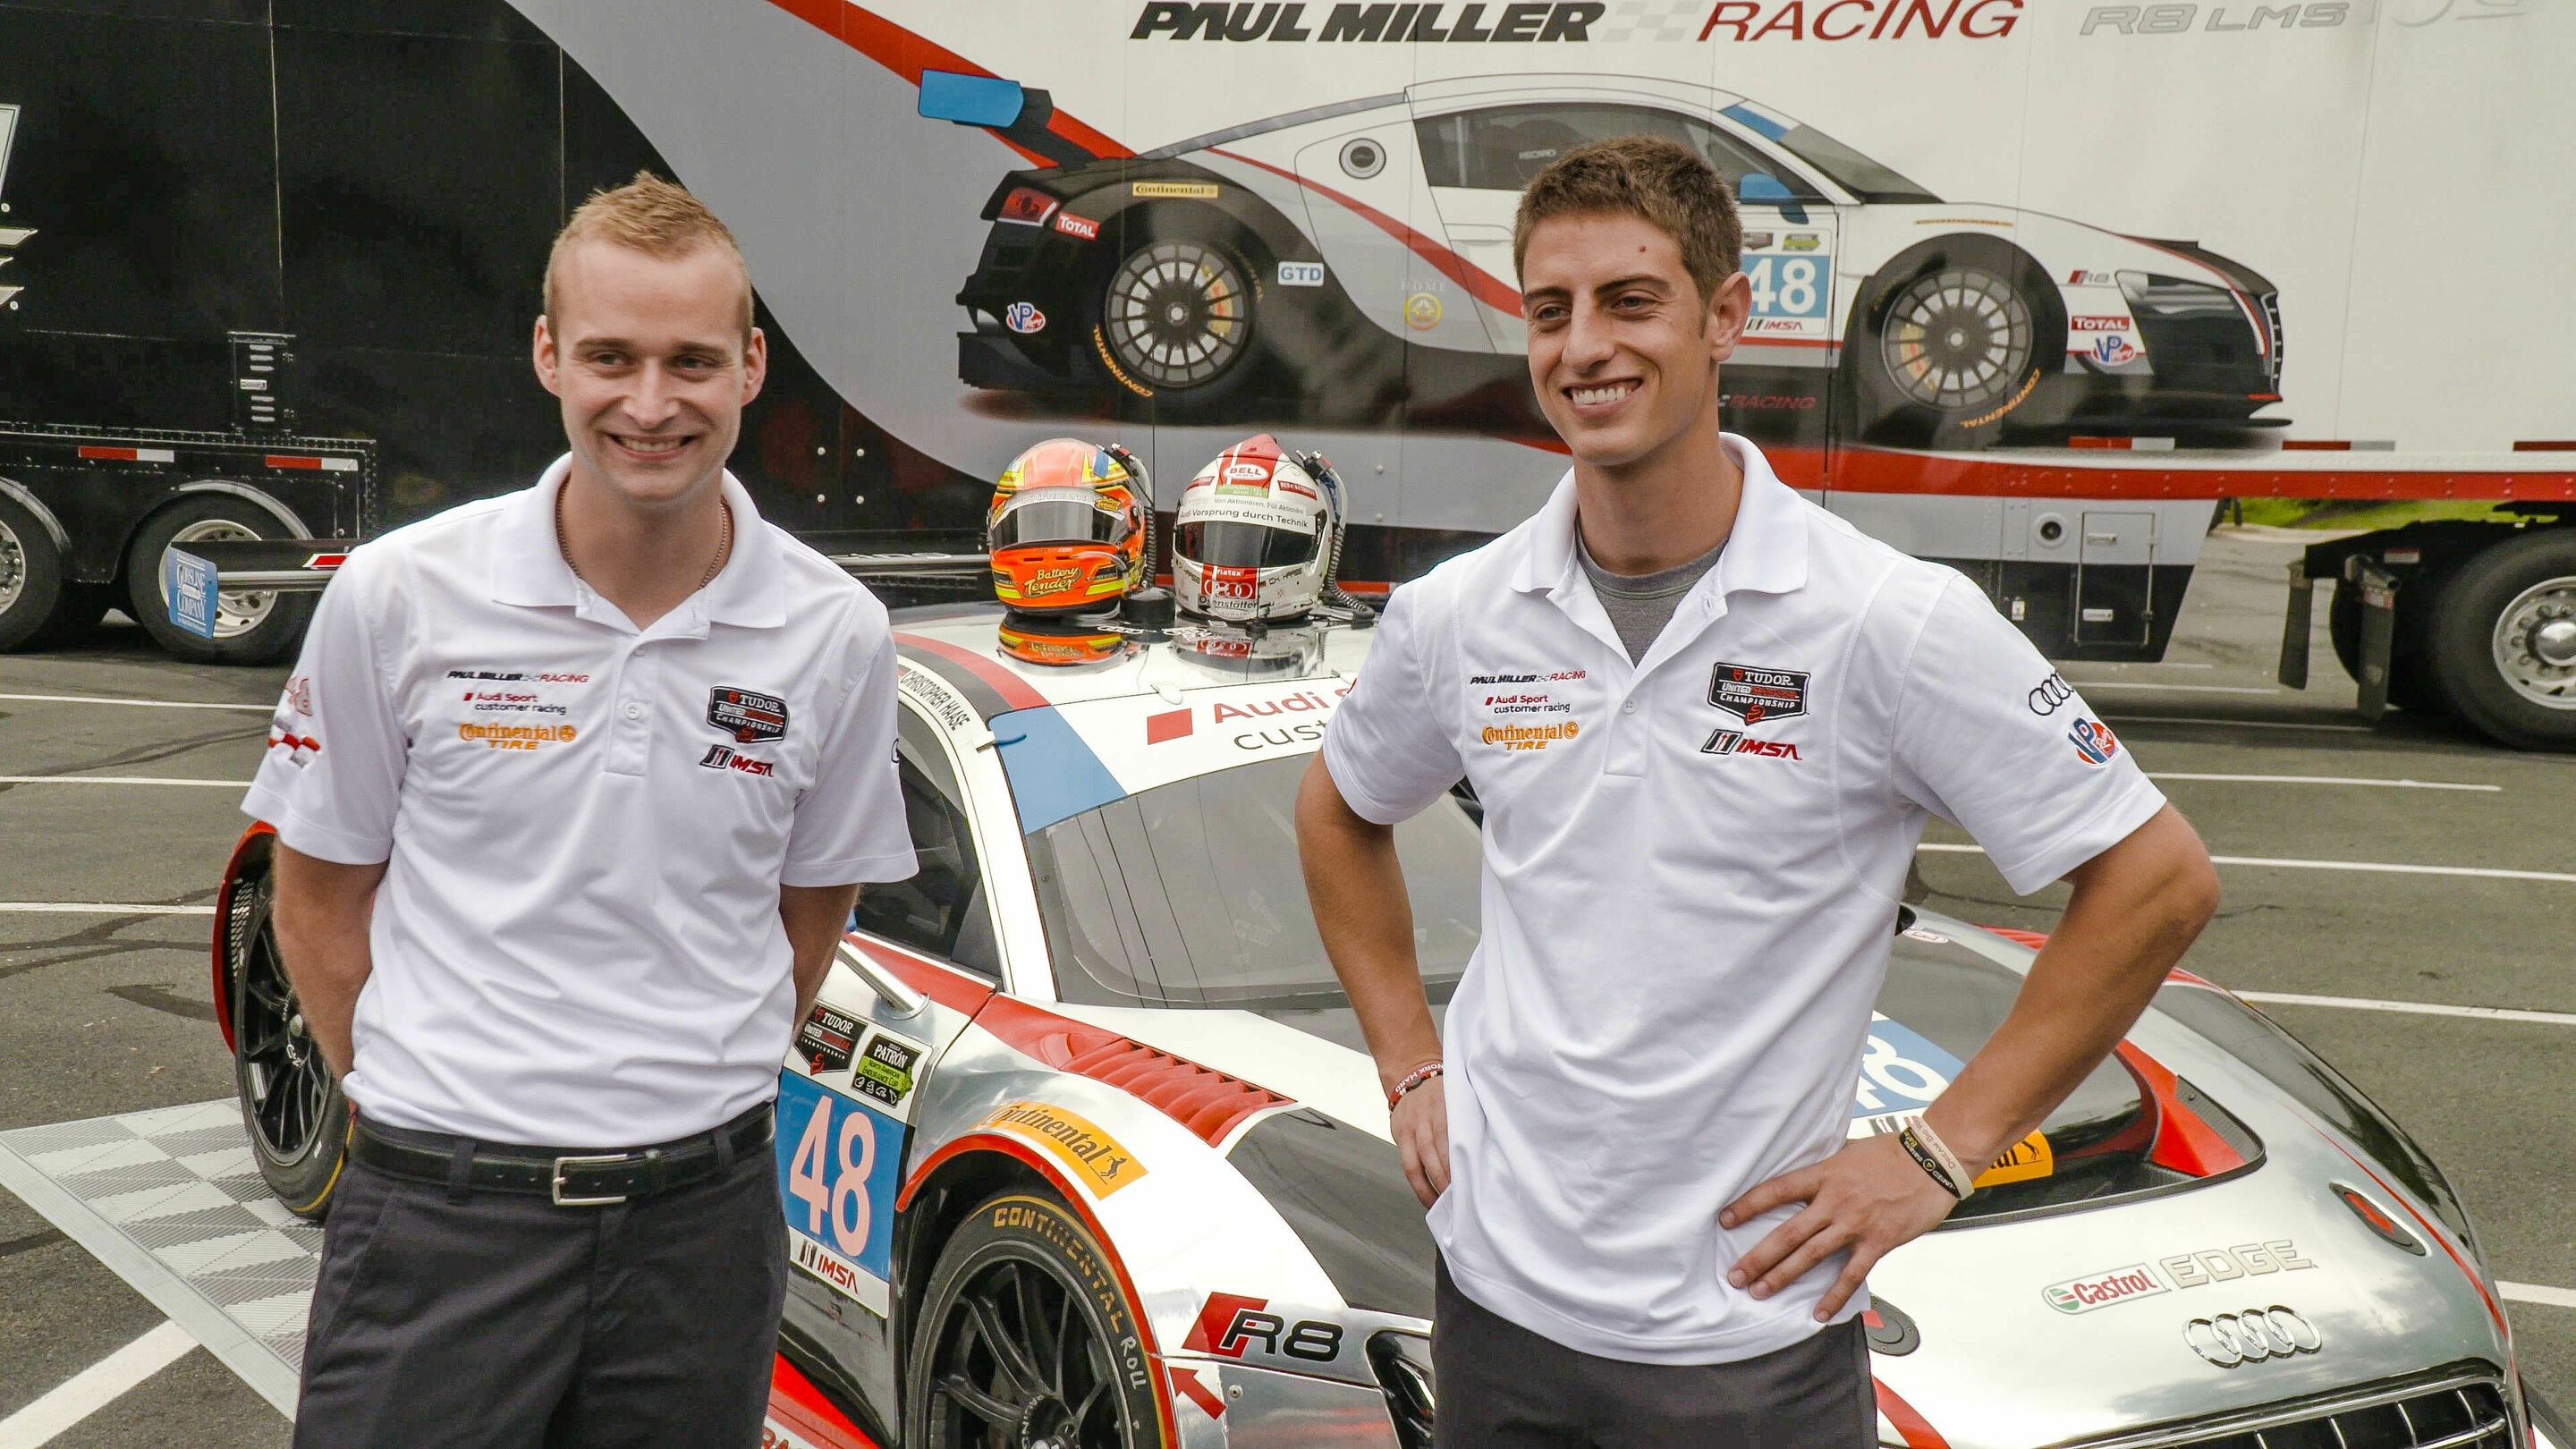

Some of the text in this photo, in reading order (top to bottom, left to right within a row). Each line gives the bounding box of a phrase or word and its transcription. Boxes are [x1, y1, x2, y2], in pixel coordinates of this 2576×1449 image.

[1131, 0, 2024, 43] PAUL MILLER RACING
[2080, 3, 2197, 36] R8
[2205, 1, 2350, 32] LMS
[1135, 183, 1205, 195] Continental
[1058, 214, 1096, 239] TOTAL
[1280, 265, 1322, 283] GTD
[1749, 258, 1817, 314] 48
[1763, 320, 1803, 330] IMSA
[2072, 318, 2129, 331] TOTAL
[1094, 323, 1154, 398] CONTINENTAL
[1729, 394, 1816, 409] RACING
[1229, 467, 1262, 476] BELL
[1192, 509, 1239, 518] Vorsprung
[1242, 511, 1273, 521] durch
[1276, 515, 1308, 529] Technik
[1038, 567, 1079, 581] Battery
[1216, 568, 1241, 577] flatex
[1024, 577, 1075, 595] Tender
[1199, 595, 1258, 609] Oenstätter
[539, 674, 589, 682] RACING
[1470, 670, 1586, 684] PAUL MILLER RACING
[1745, 672, 1794, 686] TUDOR
[1722, 682, 1751, 694] UNITED
[476, 692, 538, 703] Audi Sport
[740, 694, 780, 712] TUDOR
[900, 670, 970, 731] CHRISTOPHER HAASE
[1495, 694, 1548, 705] Audi Sport
[1720, 693, 1795, 708] CHAMPIONSHIP
[475, 703, 566, 716] customer racing
[1214, 691, 1330, 724] Audi
[1495, 703, 1571, 714] customer racing
[459, 723, 557, 741] Continental
[716, 713, 780, 733] CHAMPIONSHIP
[1482, 723, 1563, 745] Continental
[487, 740, 539, 750] TIRE
[1504, 741, 1548, 750] TIRE
[1735, 739, 1800, 760] IMSA
[729, 755, 774, 777] IMSA
[821, 1012, 854, 1034] TUDOR
[874, 1044, 909, 1069] PATRÓN
[1395, 1072, 1418, 1093] HARD
[987, 1105, 1111, 1165] Continental
[789, 1095, 875, 1257] 48
[994, 1207, 1123, 1335] CONTINENTAL
[2159, 1240, 2313, 1289] EDGE
[817, 1254, 859, 1295] IMSA
[2073, 1269, 2158, 1304] Castrol
[1219, 1308, 1344, 1362] R8
